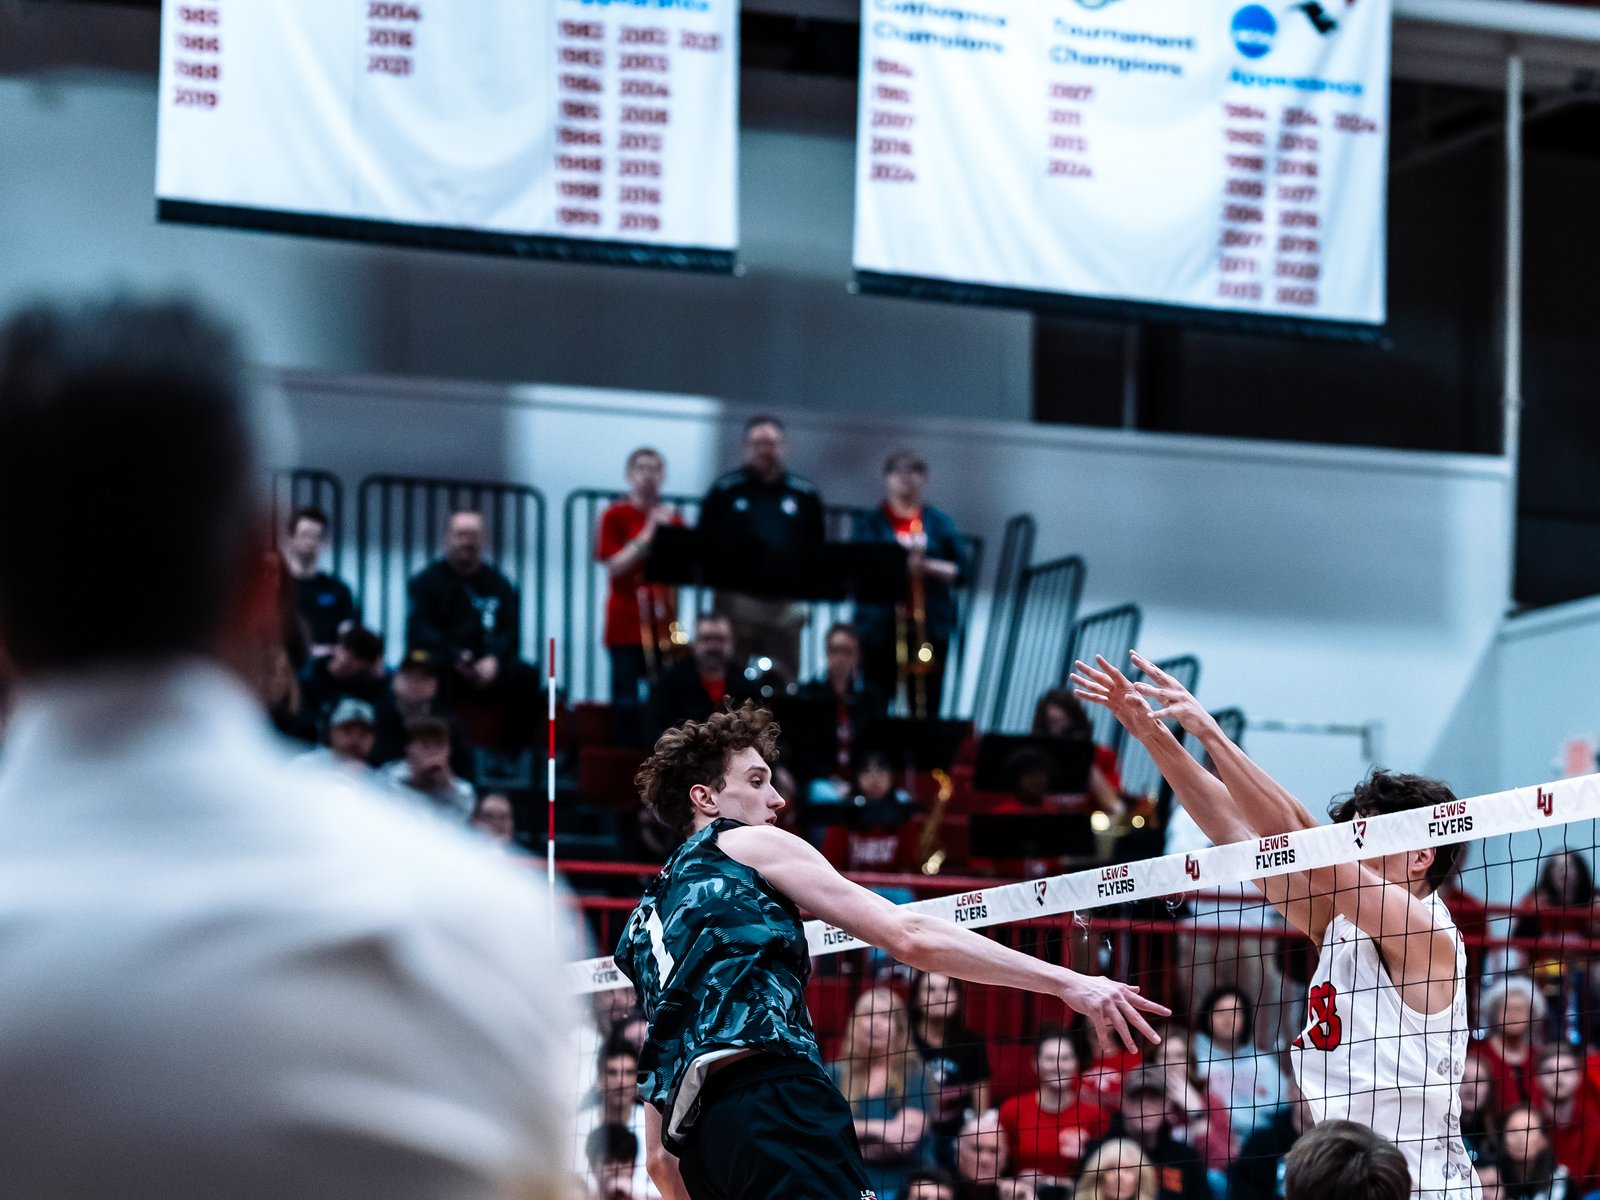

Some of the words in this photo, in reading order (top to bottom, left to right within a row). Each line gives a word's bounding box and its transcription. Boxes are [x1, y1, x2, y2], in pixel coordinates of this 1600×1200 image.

[873, 21, 1005, 52] Champions
[1054, 18, 1195, 49] Tournament
[1050, 47, 1184, 76] Champions
[1433, 801, 1467, 819] LEWIS
[1428, 816, 1473, 838] FLYERS
[1259, 835, 1289, 852] LEWIS
[1255, 848, 1295, 869] FLYERS
[1101, 865, 1129, 881] LEWIS
[1098, 878, 1135, 897] FLYERS
[956, 892, 982, 907] LEWIS
[954, 905, 988, 923] FLYERS
